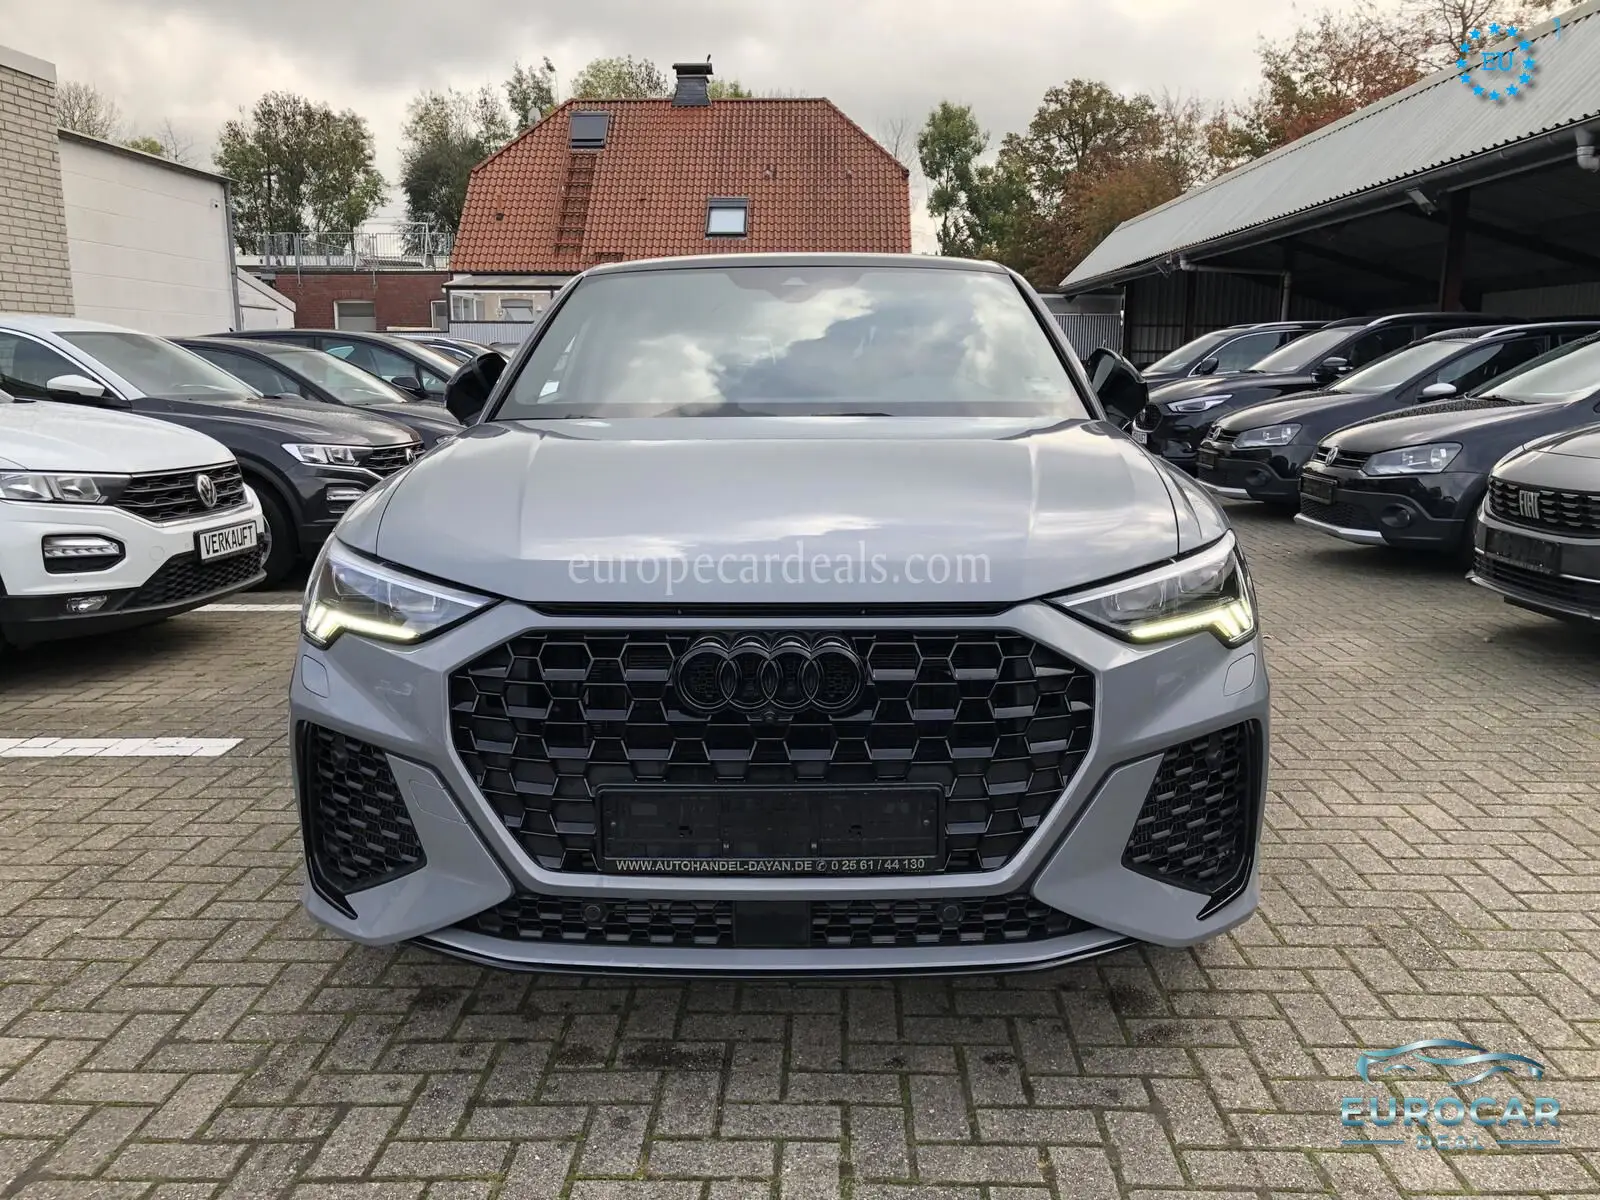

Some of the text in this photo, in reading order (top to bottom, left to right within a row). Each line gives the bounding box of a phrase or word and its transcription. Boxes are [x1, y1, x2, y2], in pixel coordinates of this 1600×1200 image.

[1519, 490, 1540, 519] FIAT
[204, 526, 253, 555] VERKAUFT
[616, 859, 813, 872] WWW.AUTOHANDEL-DAYAN.DE
[831, 860, 839, 870] 0
[860, 860, 874, 870] 61
[884, 860, 900, 869] 44
[902, 859, 925, 869] 130
